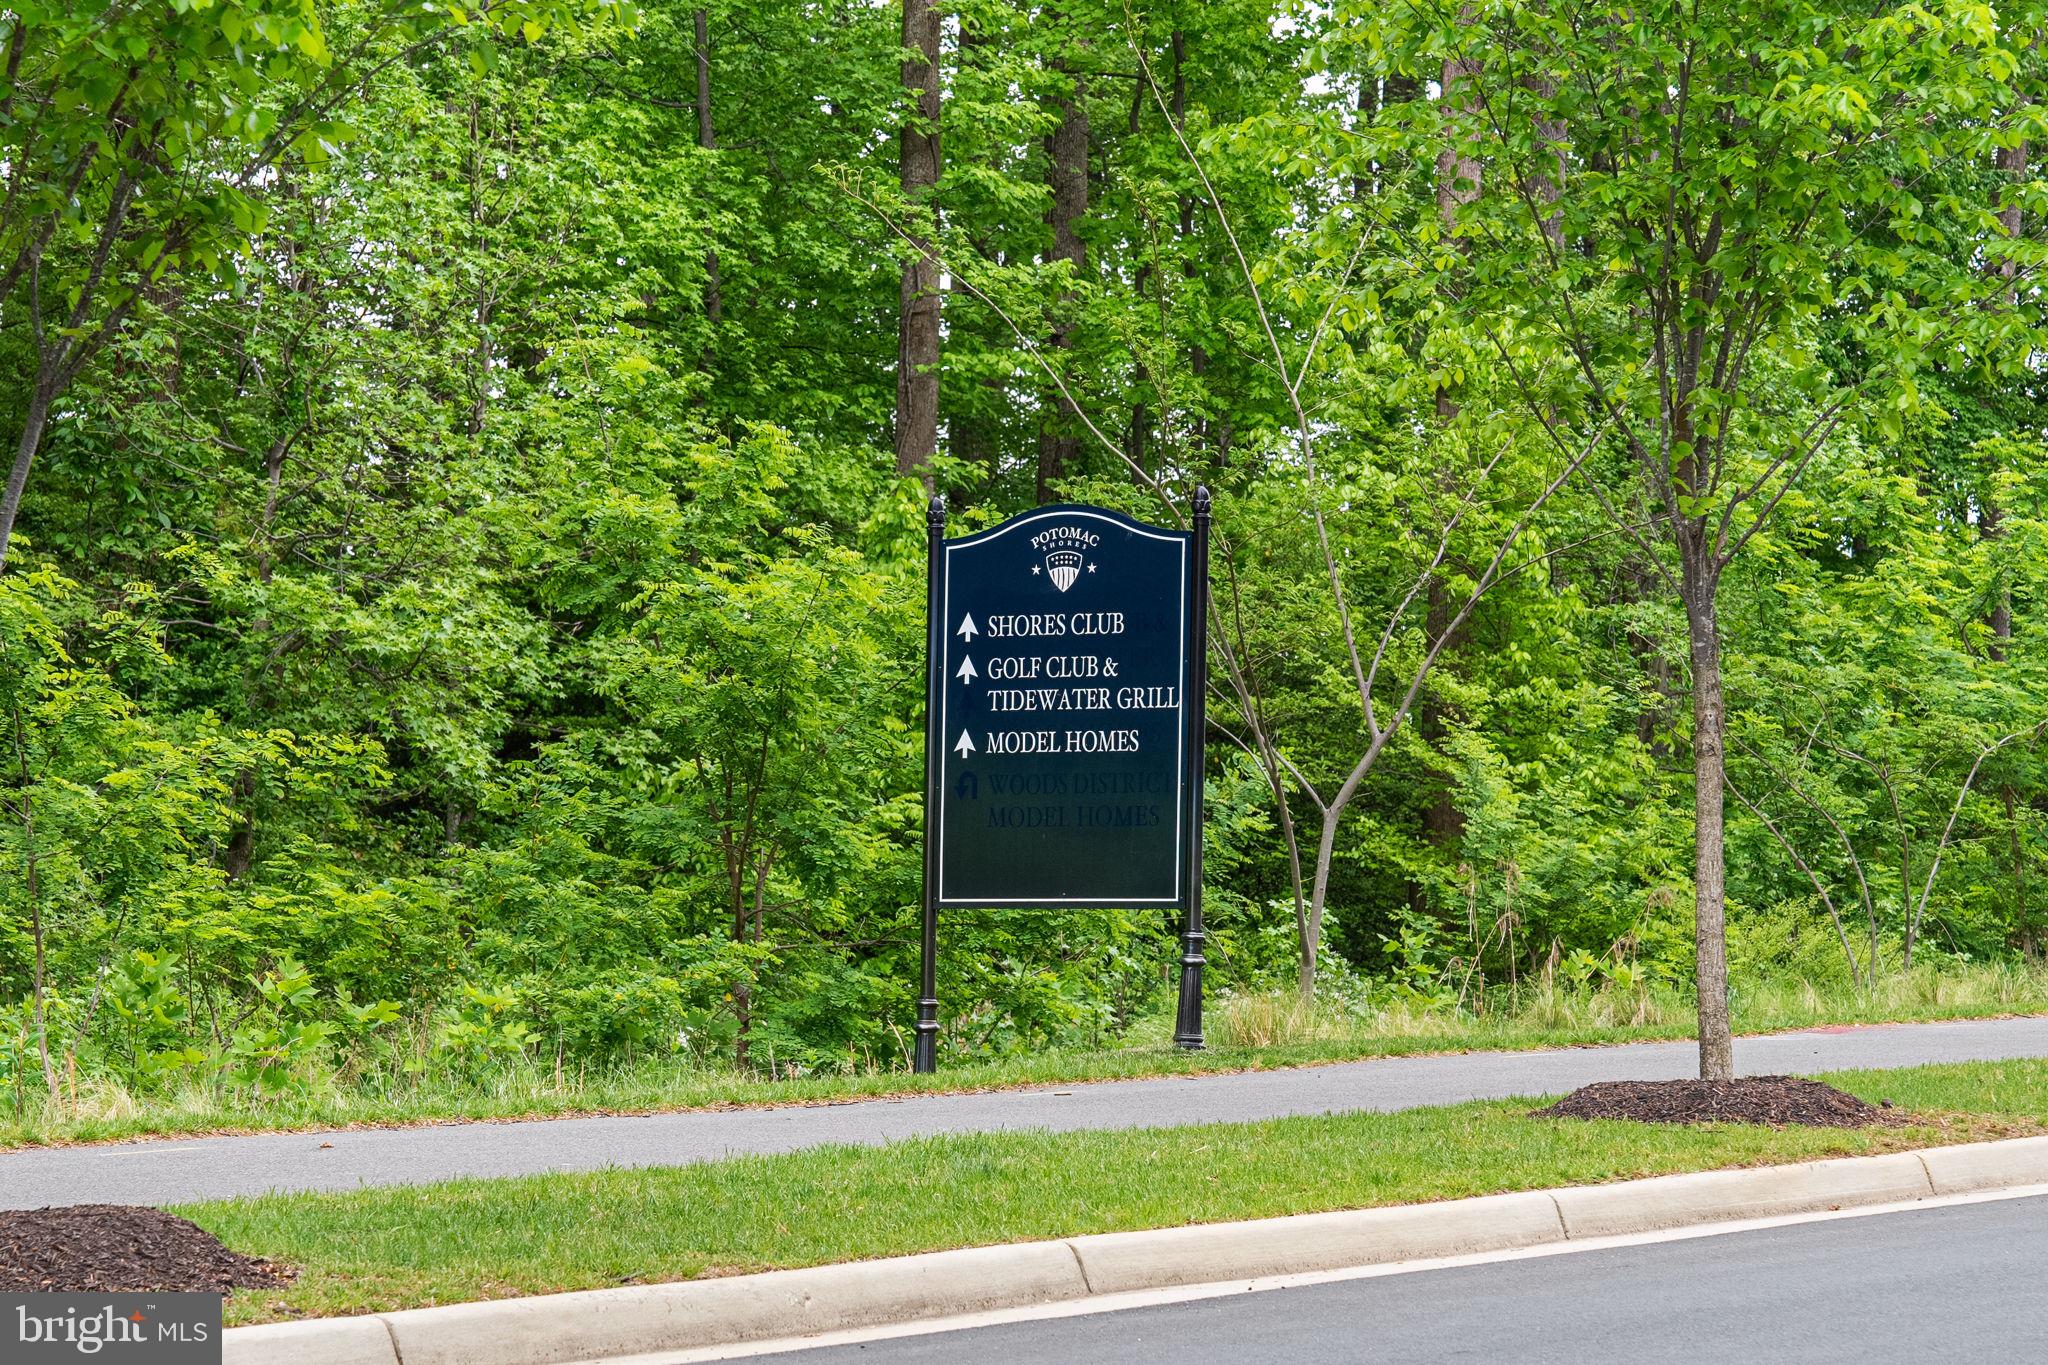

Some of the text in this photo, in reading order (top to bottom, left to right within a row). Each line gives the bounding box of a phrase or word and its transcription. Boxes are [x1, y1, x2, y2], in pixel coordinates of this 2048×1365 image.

[1030, 526, 1100, 549] POTOMAC
[1042, 540, 1088, 552] SHORES
[987, 615, 1065, 638] SHORES
[1070, 612, 1125, 636] CLUB
[988, 656, 1041, 680] GOLF
[1045, 655, 1099, 679] CLUB
[1103, 656, 1119, 678] &
[987, 686, 1178, 712] TIDEWATER GRILL
[986, 731, 1062, 754] MODEL
[1065, 729, 1140, 753] HOMES
[988, 773, 1067, 796] WOODS
[988, 804, 1160, 829] MODEL HOMES
